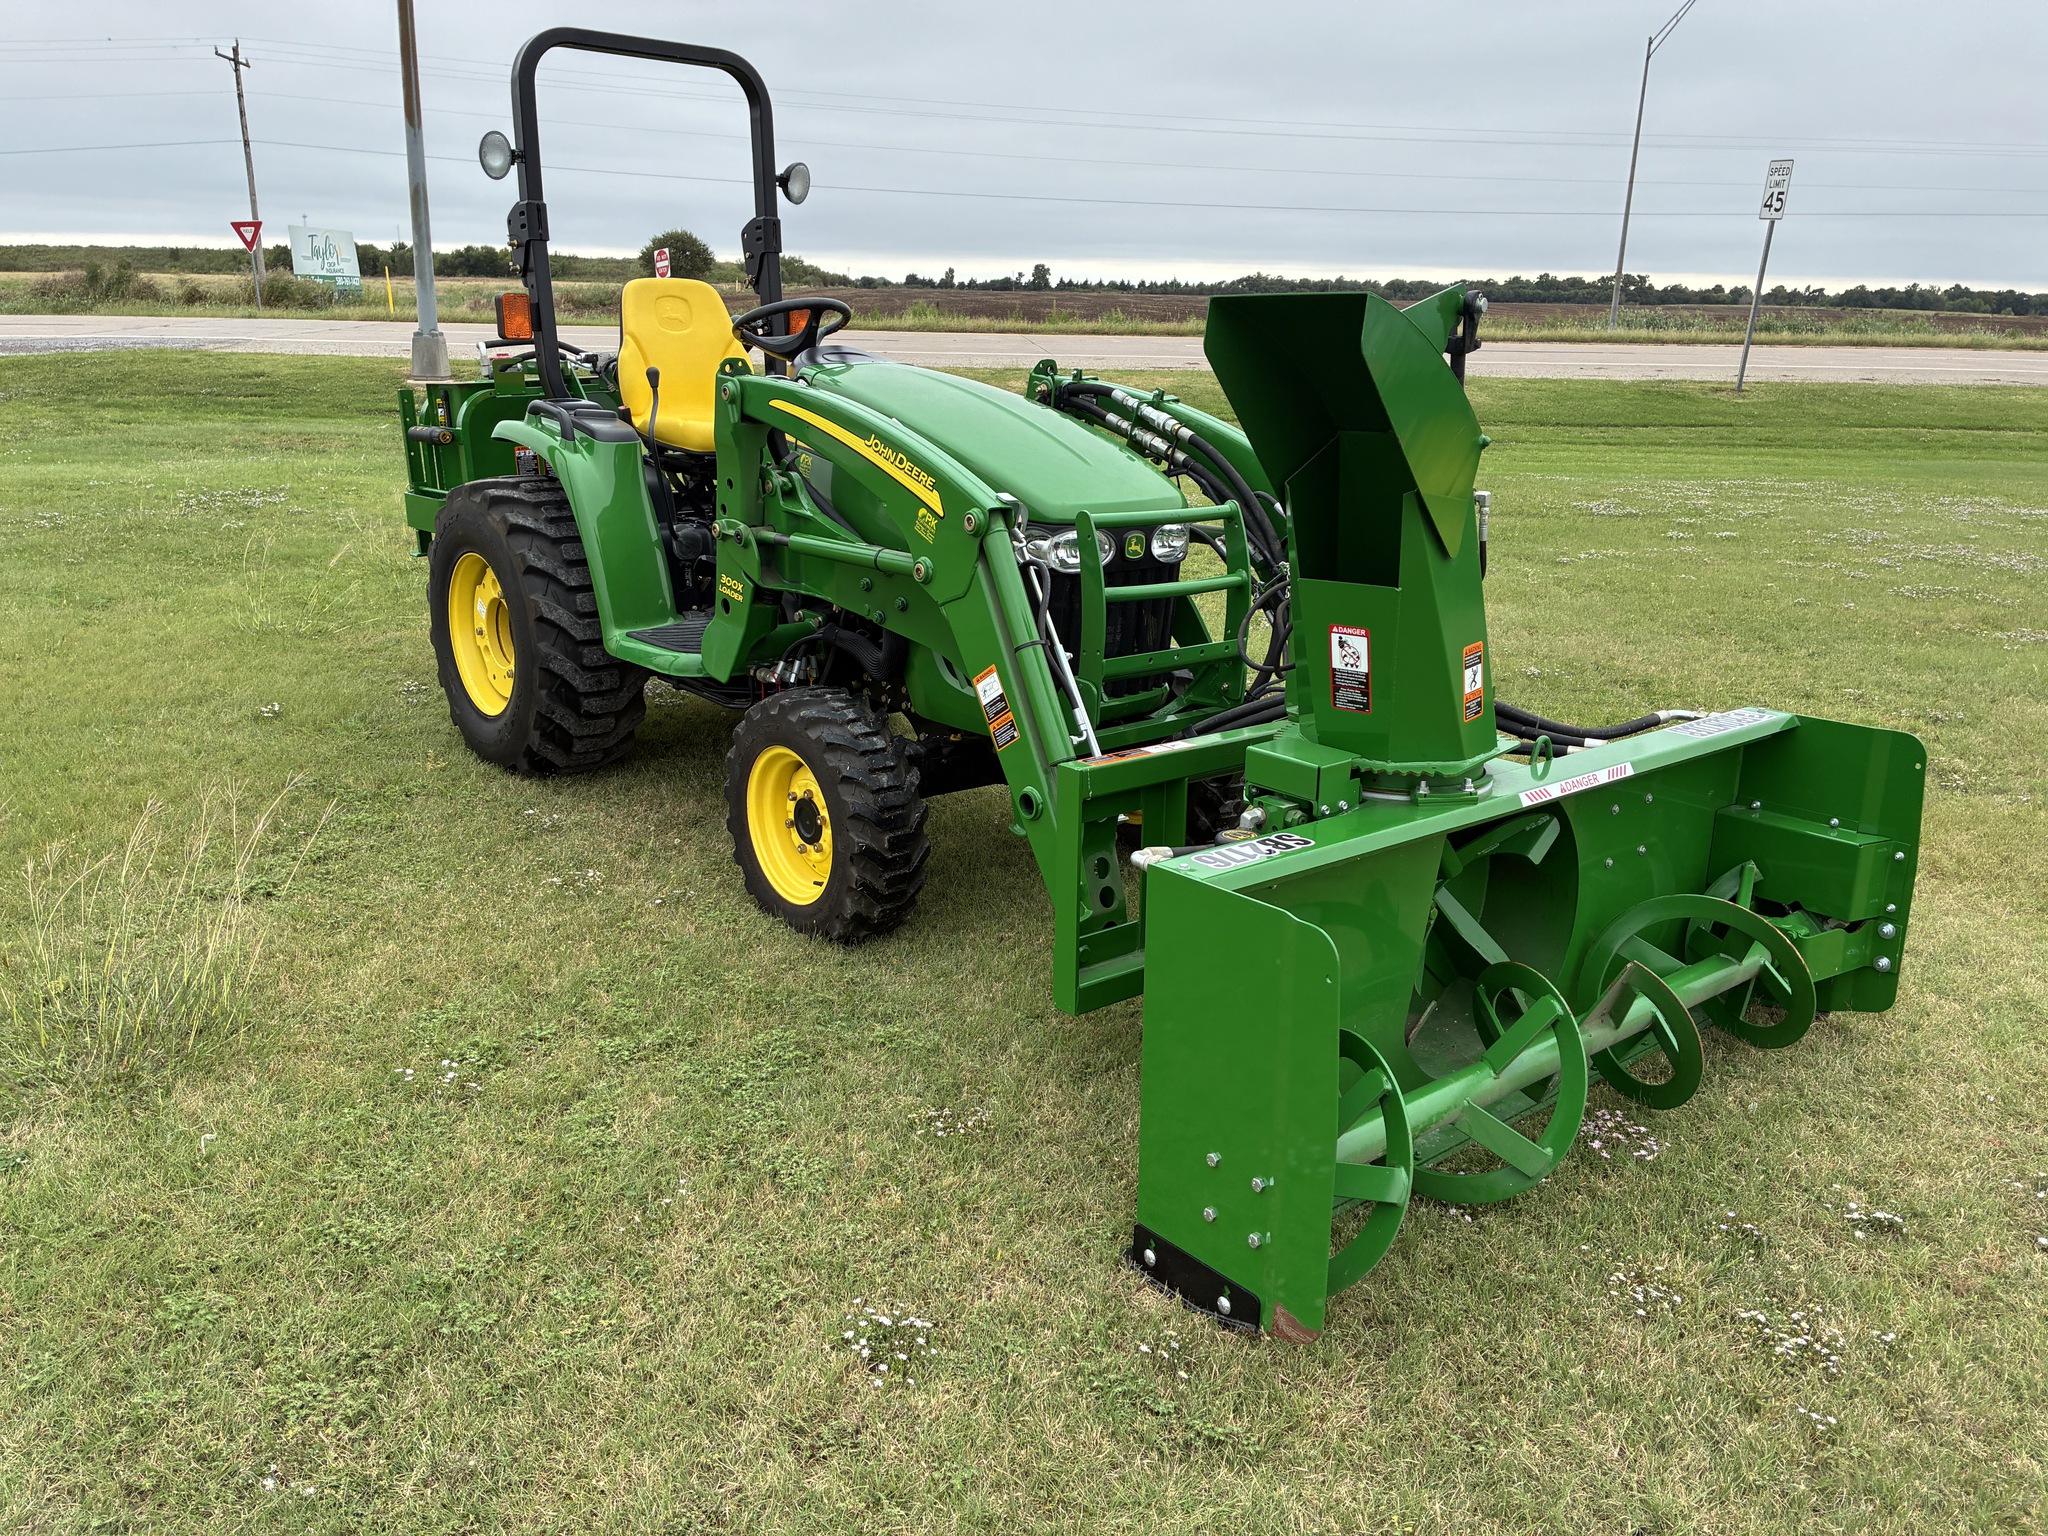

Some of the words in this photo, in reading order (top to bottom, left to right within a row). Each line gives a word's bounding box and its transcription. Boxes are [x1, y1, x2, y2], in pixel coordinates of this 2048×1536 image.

[1770, 167, 1790, 176] SPEED
[1769, 180, 1786, 188] LIMIT
[1763, 191, 1785, 212] 45
[308, 234, 340, 271] Taylor
[864, 434, 896, 464] JOHN
[896, 454, 936, 490] DEERE
[925, 512, 938, 530] PK
[720, 574, 743, 593] 300X
[719, 584, 743, 602] LOADER
[1338, 627, 1366, 636] DANGER
[1565, 774, 1600, 792] DANGER
